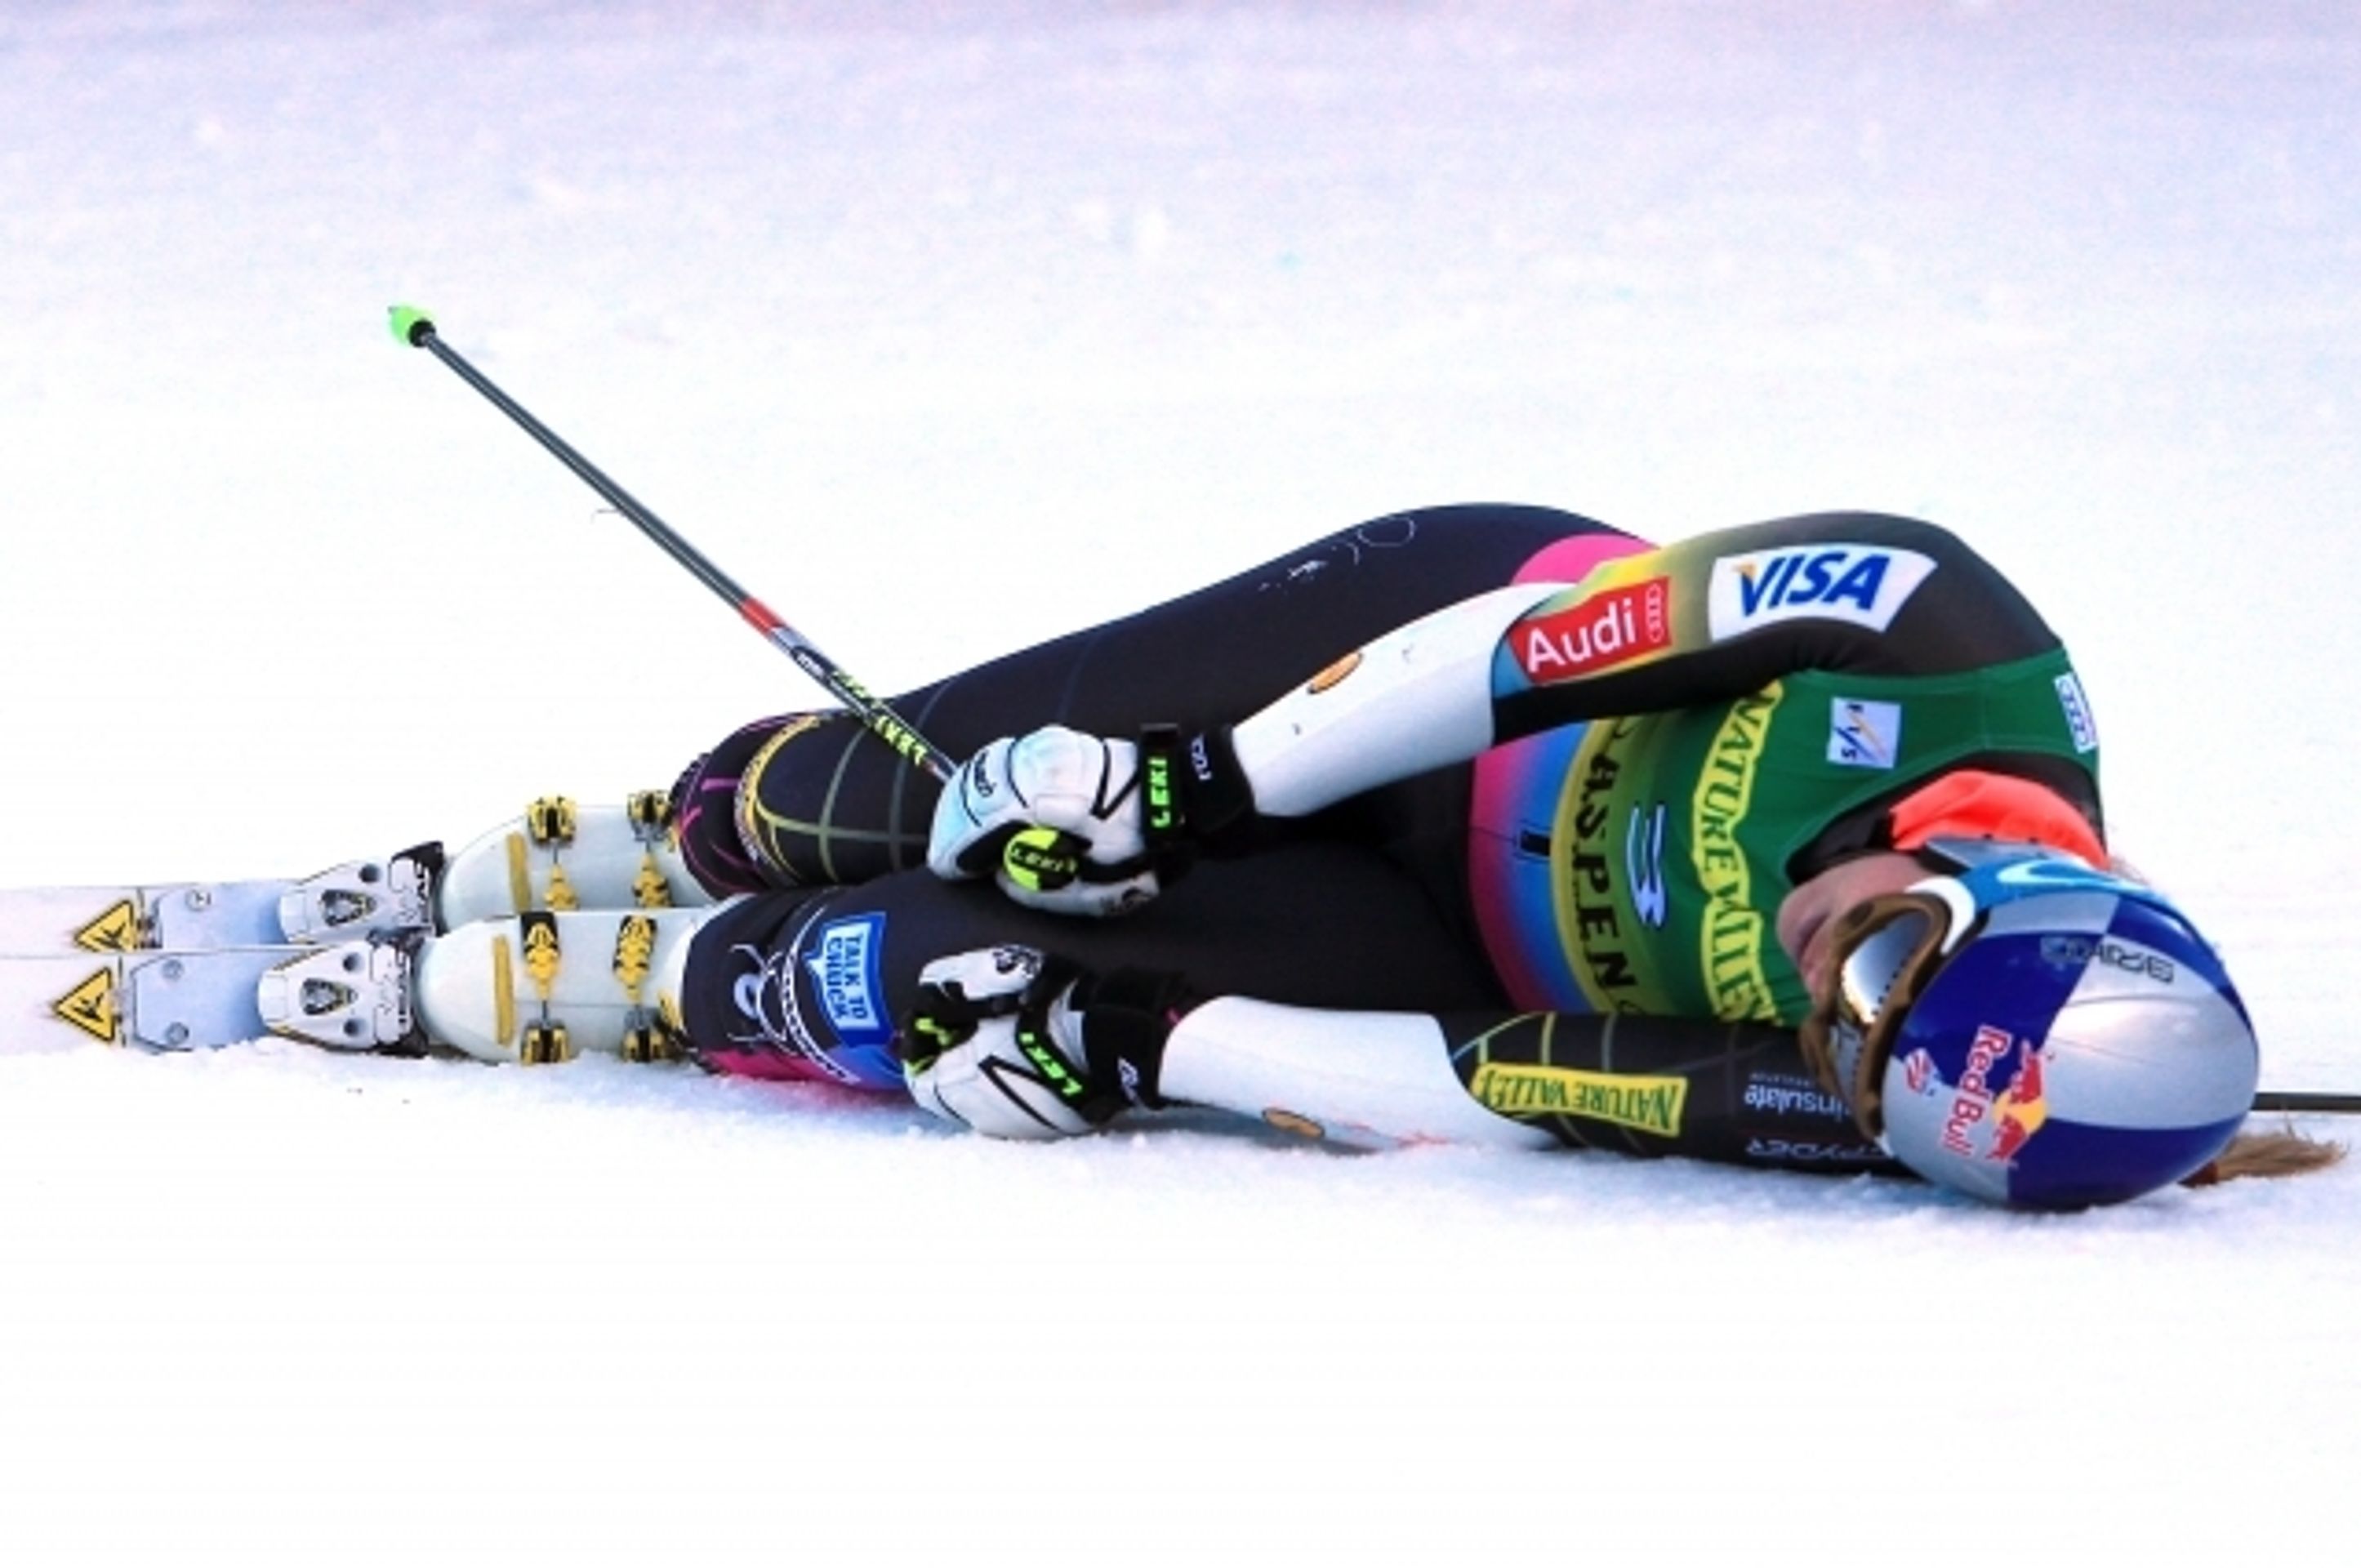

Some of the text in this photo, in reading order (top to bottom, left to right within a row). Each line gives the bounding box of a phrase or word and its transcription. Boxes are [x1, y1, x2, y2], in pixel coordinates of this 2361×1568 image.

[1735, 551, 1891, 617] VISA
[1525, 596, 1638, 675] Audi
[1147, 756, 1172, 828] LEKI
[1701, 693, 1773, 873] NATURE
[1573, 752, 1637, 991] ASPEN
[1626, 803, 1667, 928] 3
[825, 936, 849, 1020] CHUCK
[844, 933, 869, 1020] TALK TO
[1019, 1031, 1084, 1098] LEKI
[1480, 1069, 1679, 1130] NATURE VALLEY
[1744, 1084, 1851, 1123] insulate
[1942, 1026, 2012, 1156] Red Bull
